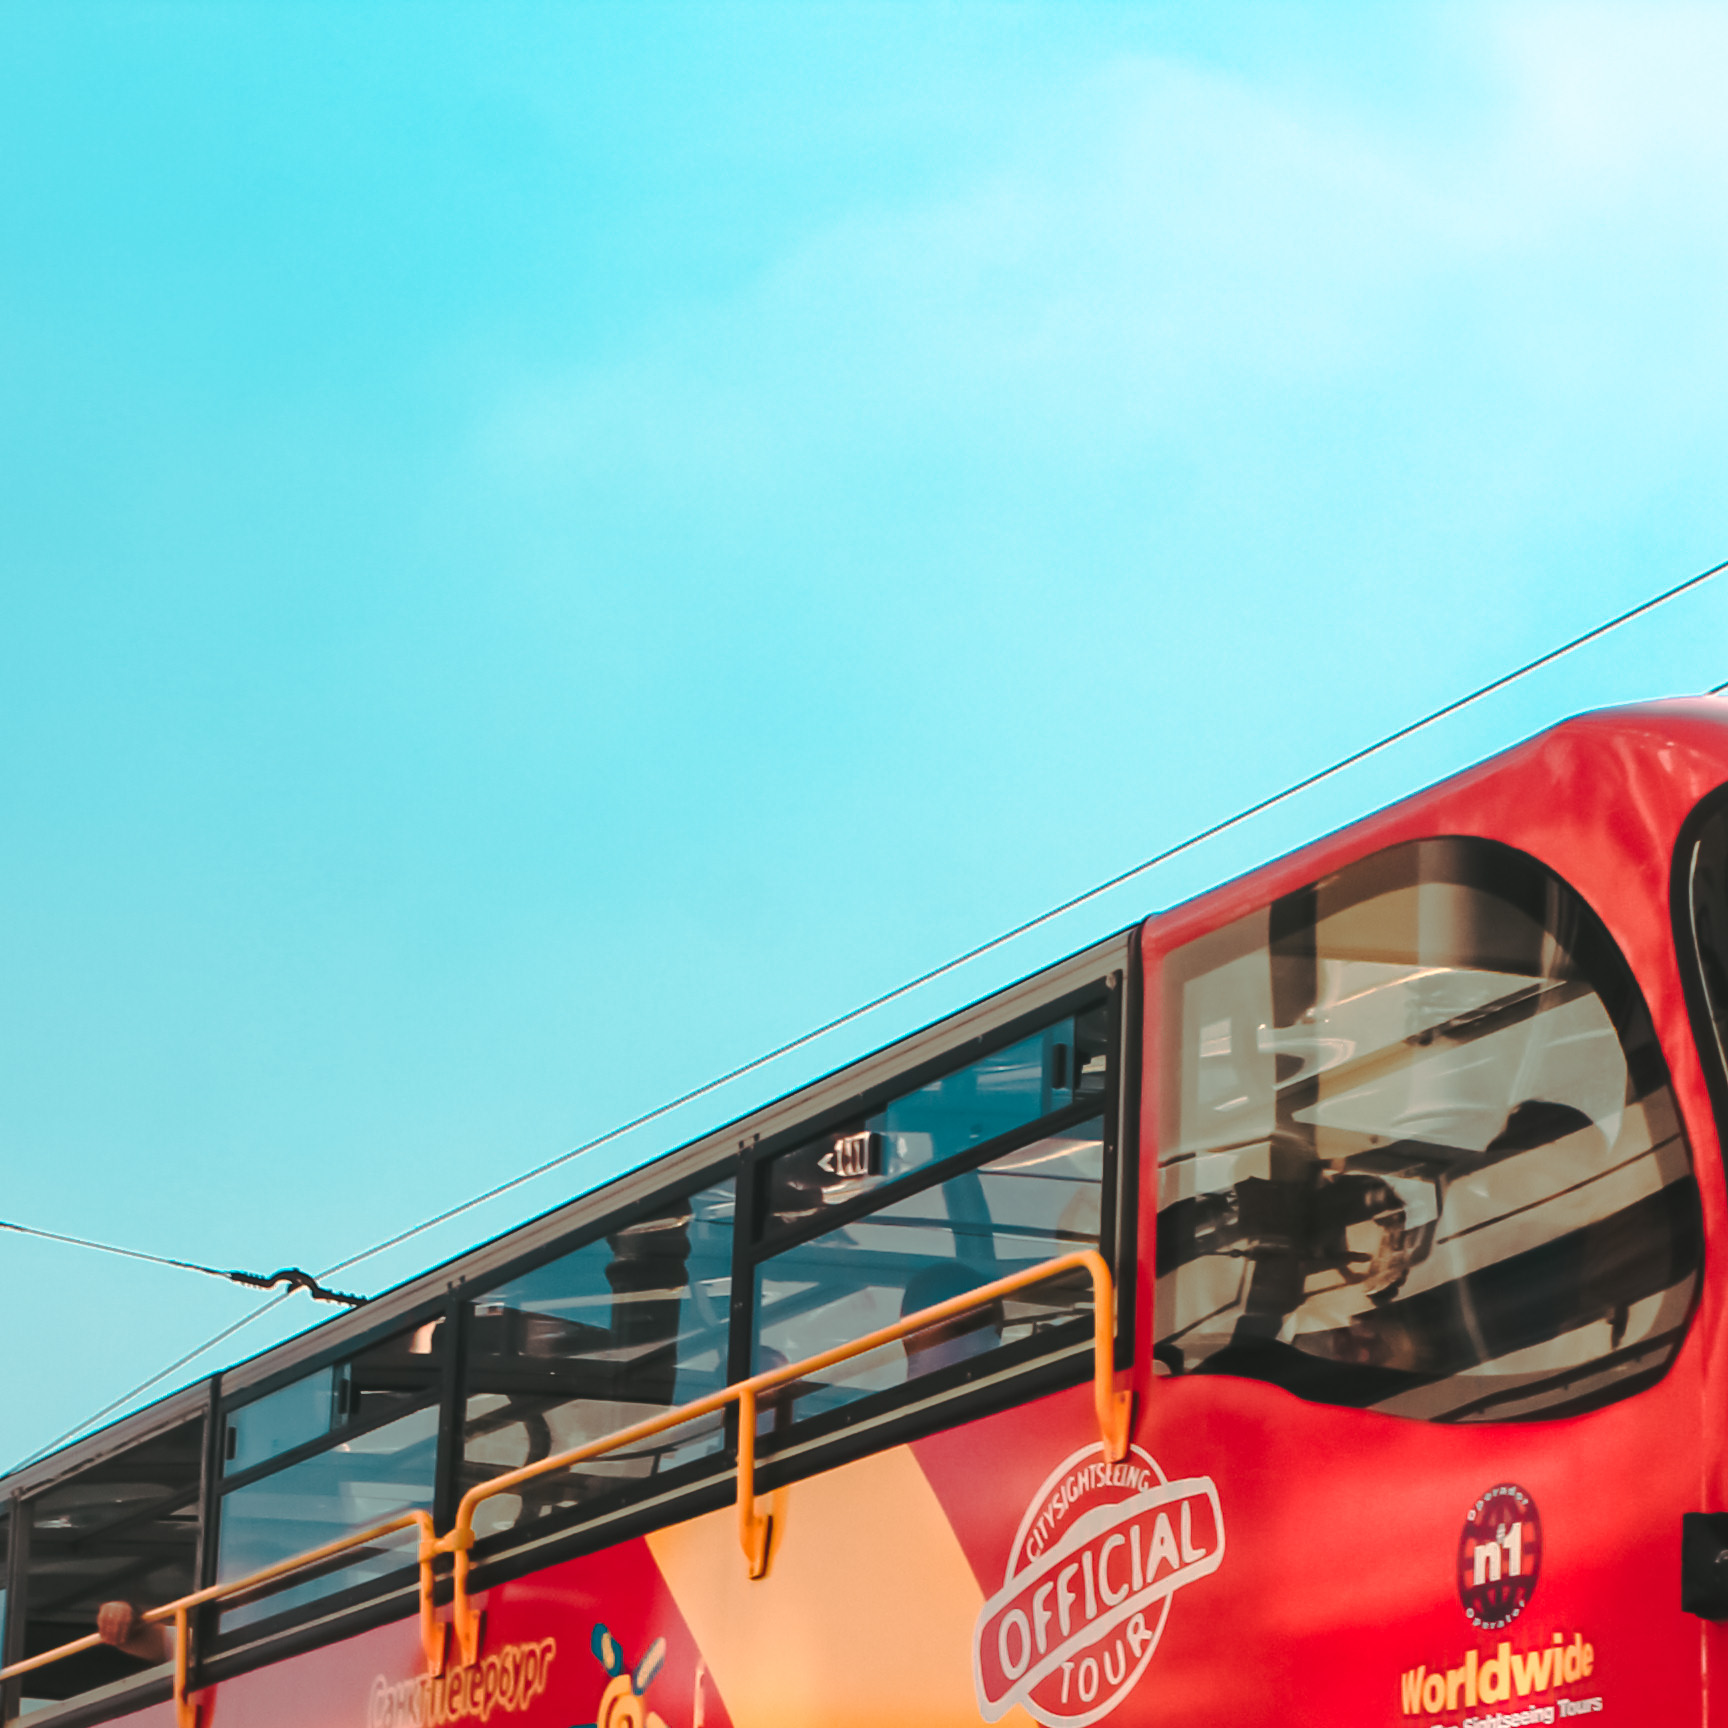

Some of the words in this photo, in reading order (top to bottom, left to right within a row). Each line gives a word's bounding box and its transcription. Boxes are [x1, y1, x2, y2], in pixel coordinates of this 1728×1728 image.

[997, 1500, 1208, 1682] OFFICIAL
[1059, 1611, 1152, 1705] TOUR
[1401, 1632, 1595, 1716] Worldwide
[1557, 1697, 1603, 1718] Tours
